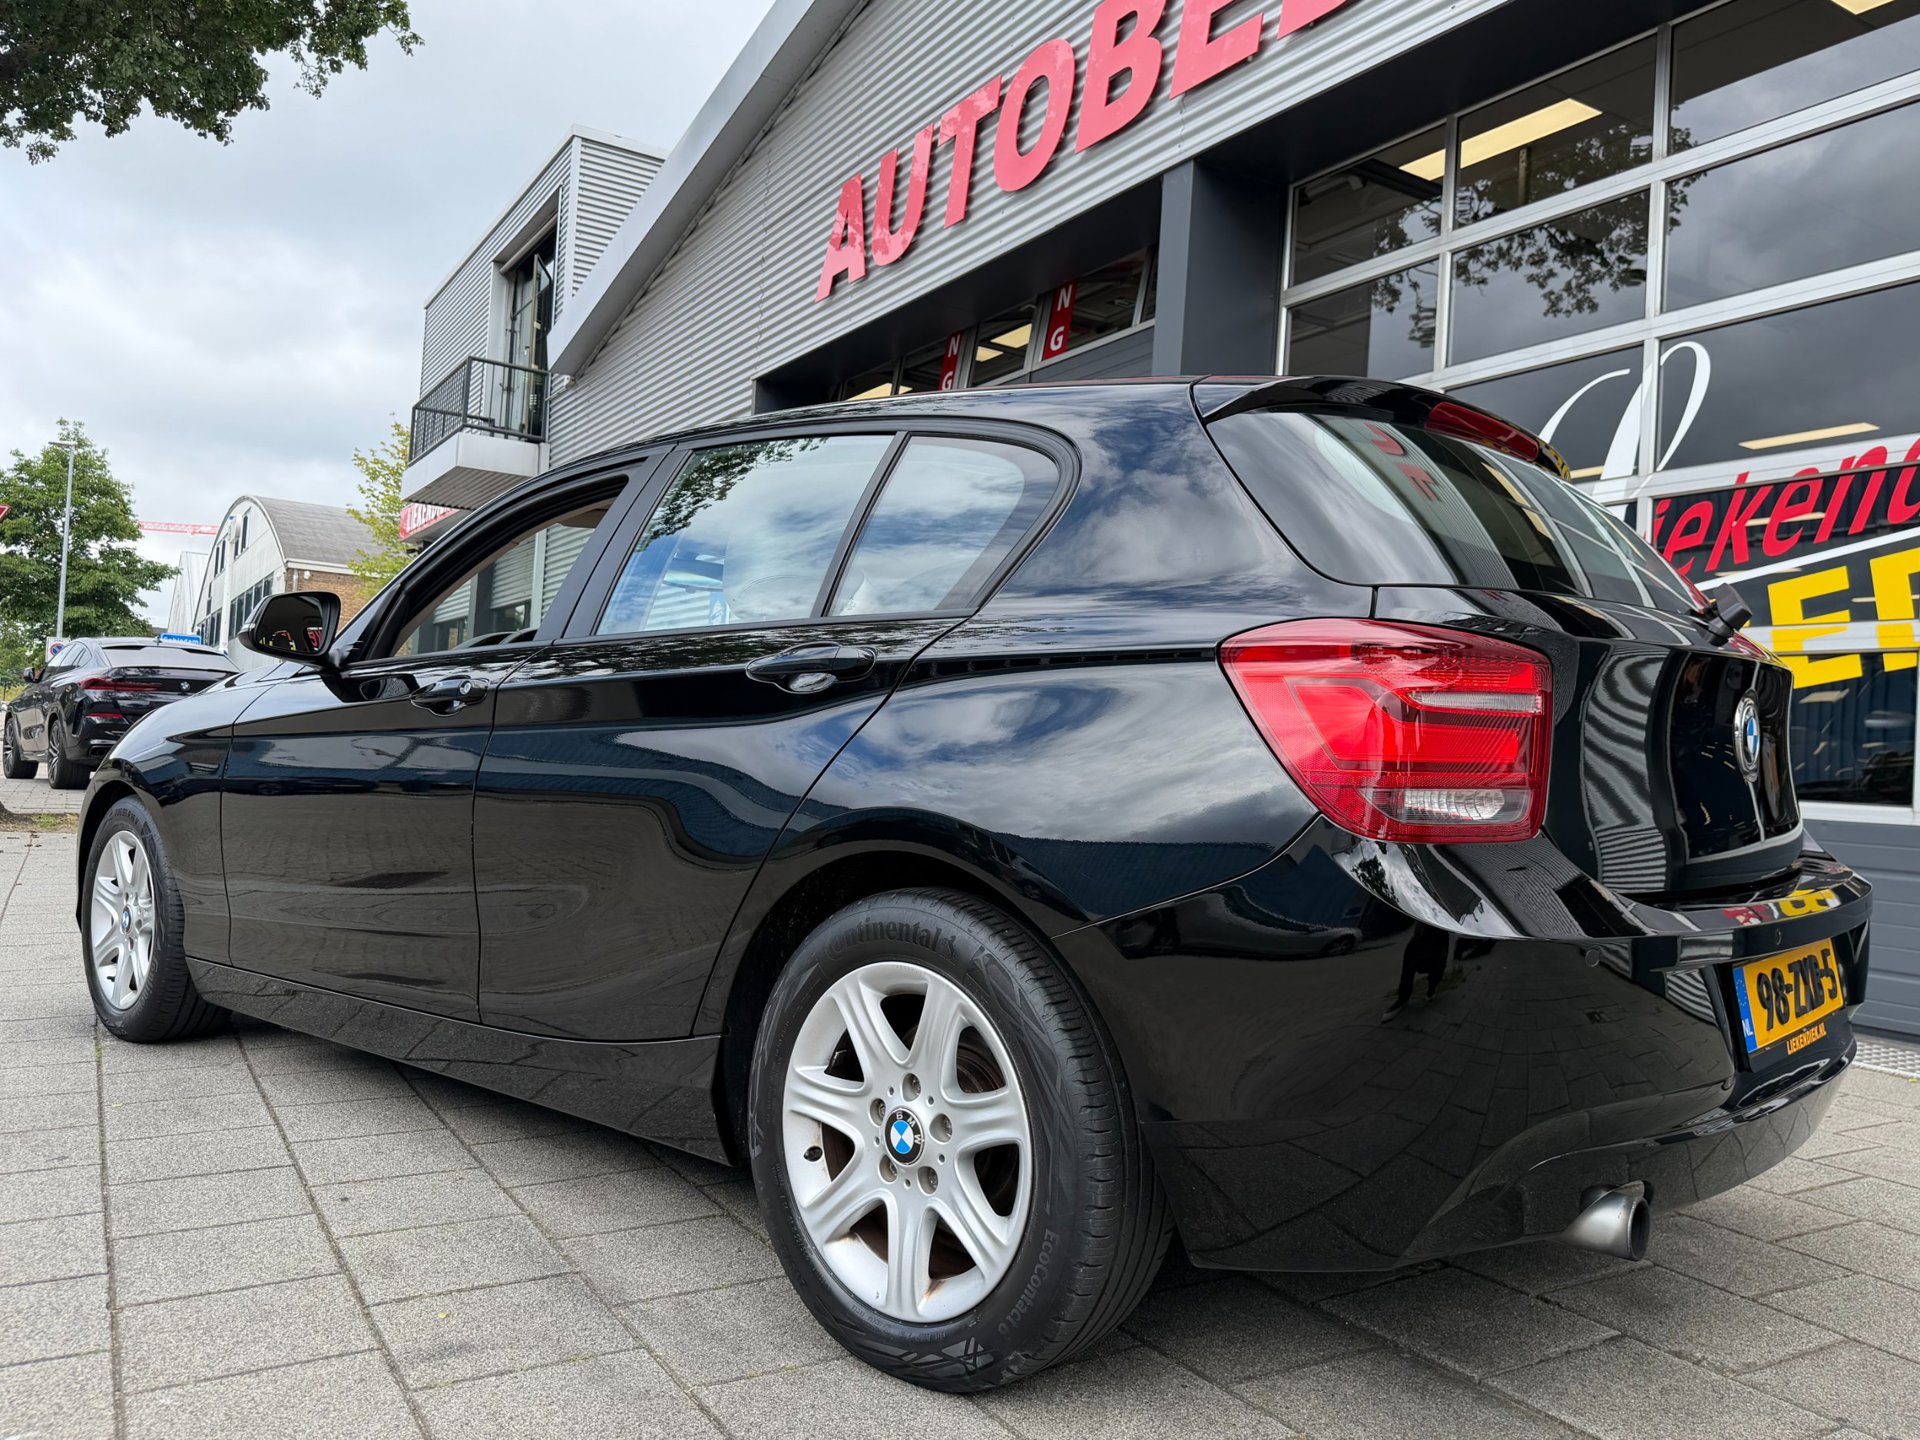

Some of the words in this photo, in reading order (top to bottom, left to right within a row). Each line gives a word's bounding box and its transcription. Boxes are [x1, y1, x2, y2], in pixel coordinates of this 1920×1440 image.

[815, 0, 1346, 303] AUTOBE
[1742, 1019, 1753, 1037] NL
[1757, 948, 1837, 1031] 98-ZXB-5
